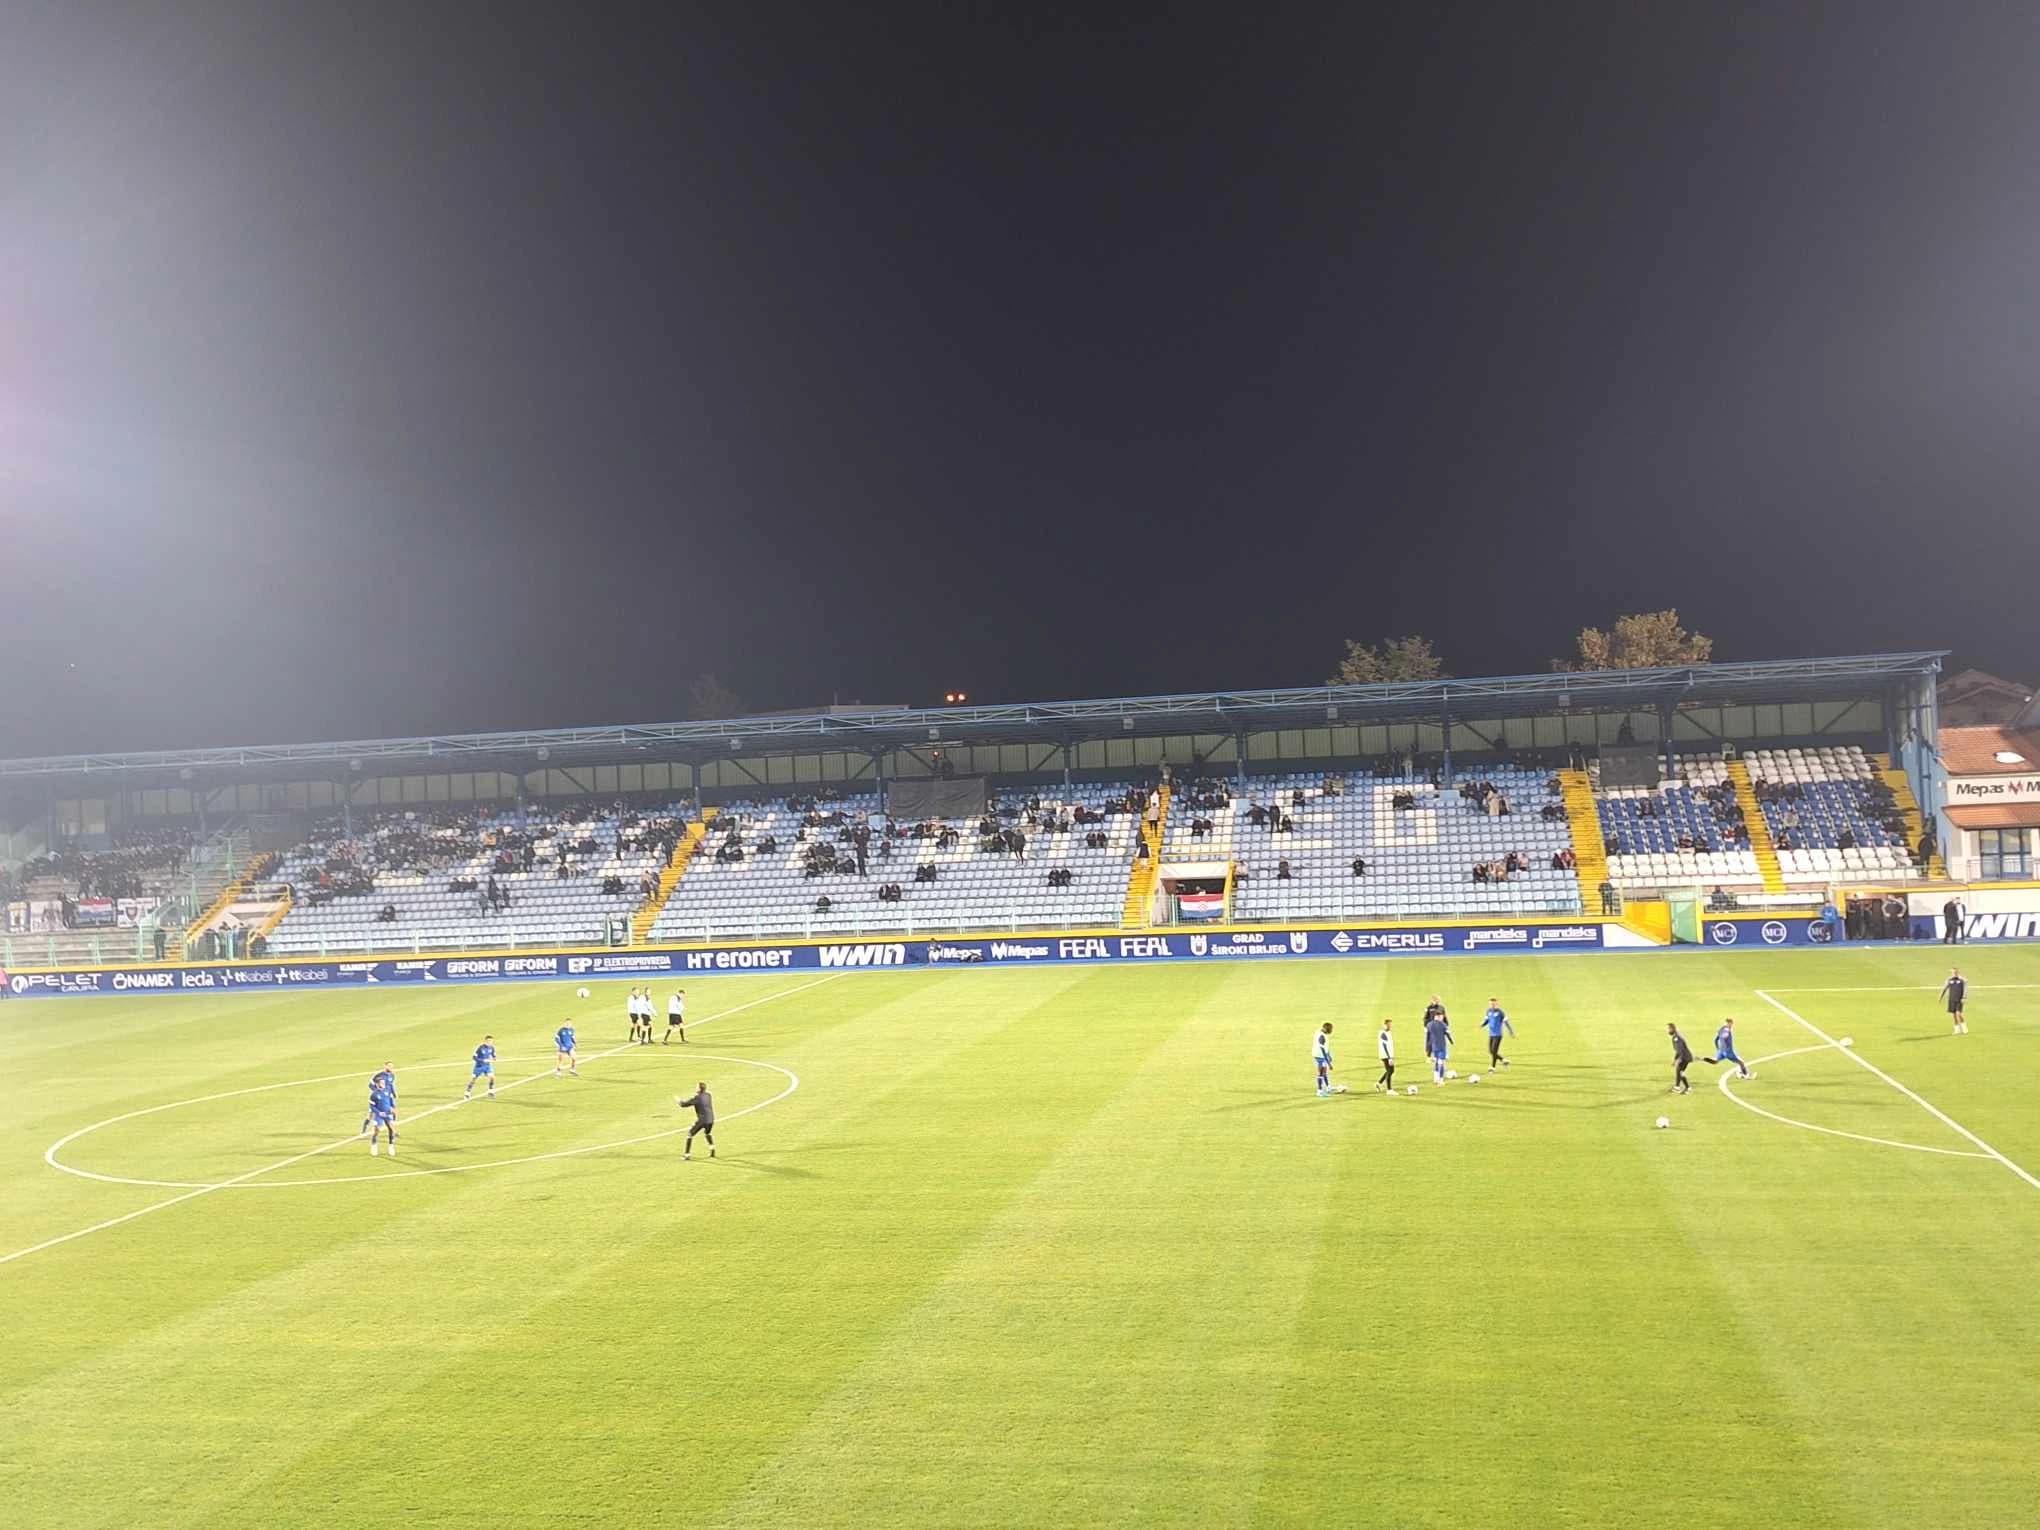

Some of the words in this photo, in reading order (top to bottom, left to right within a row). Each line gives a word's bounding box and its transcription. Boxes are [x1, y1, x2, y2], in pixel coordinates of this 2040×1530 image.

[1956, 784, 2004, 797] Mepas
[1232, 934, 1264, 943] GRAD
[1357, 933, 1444, 947] EMERUS
[1008, 945, 1049, 959] Mepas
[1059, 939, 1111, 958] FEAL
[1120, 937, 1173, 957] FEAL
[1211, 944, 1247, 955] ŠIROKI
[1248, 944, 1287, 955] BRIJEG
[28, 973, 102, 987] PELET
[127, 973, 174, 987] NAMEX
